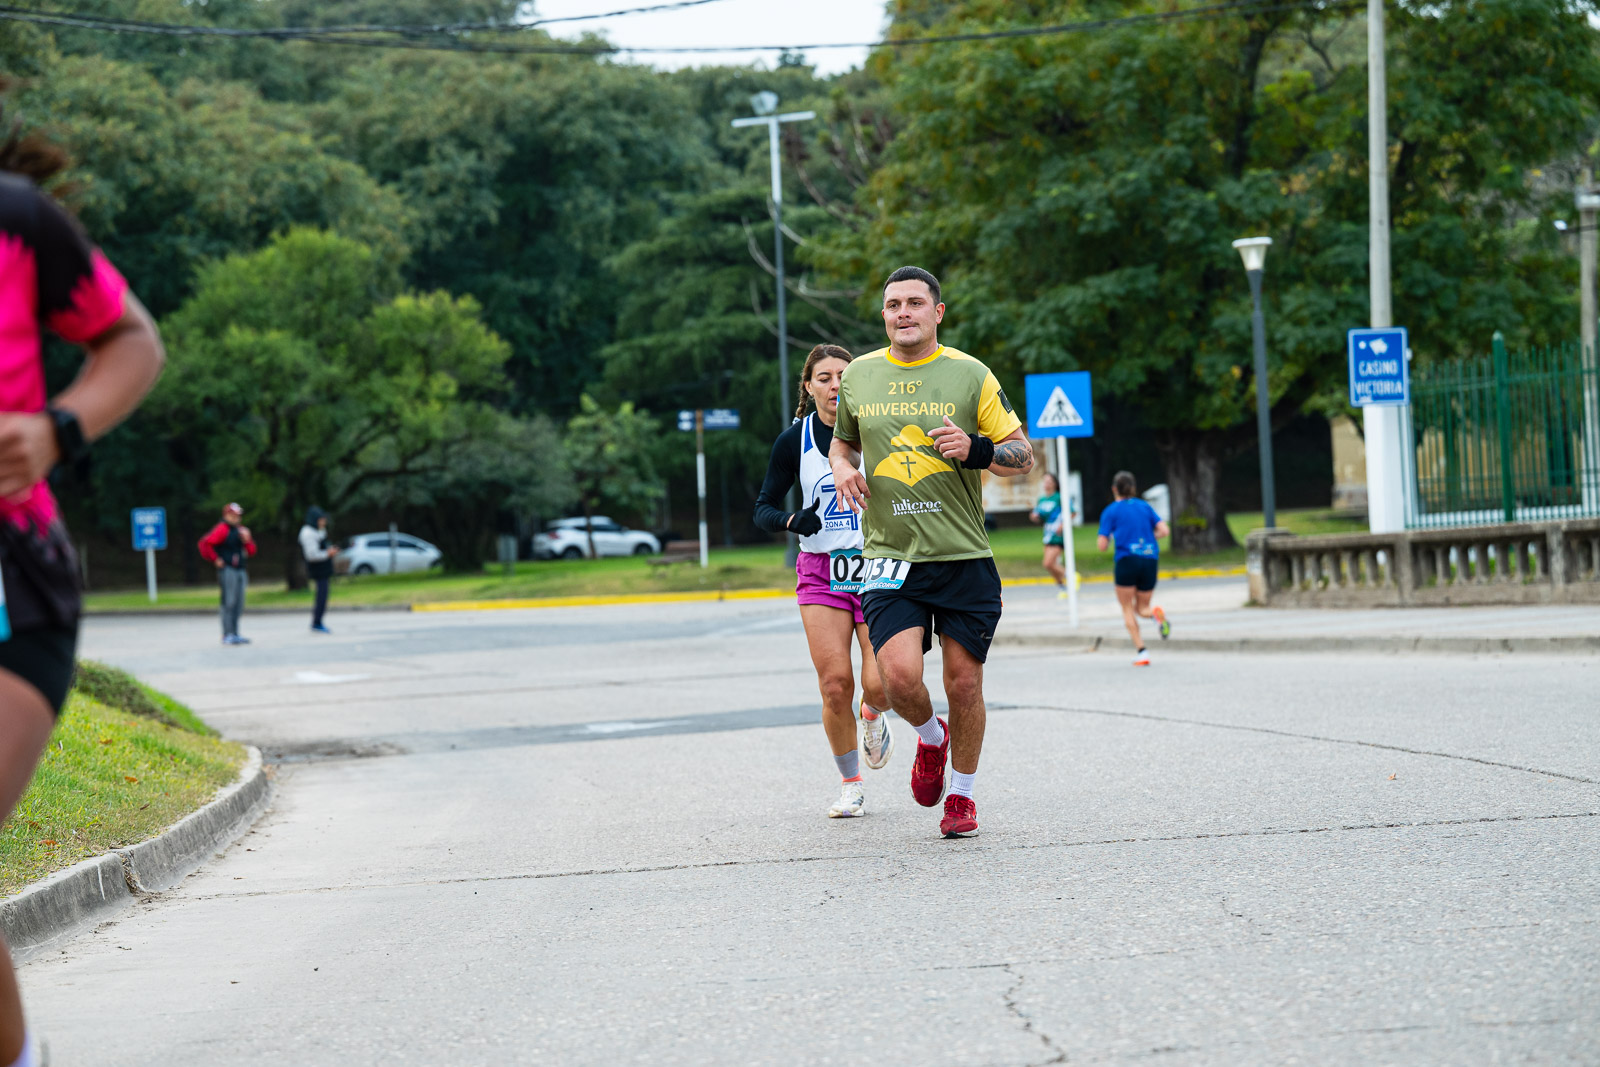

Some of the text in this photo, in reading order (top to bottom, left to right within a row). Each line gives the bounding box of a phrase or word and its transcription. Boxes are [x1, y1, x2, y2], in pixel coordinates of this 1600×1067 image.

[1359, 360, 1398, 377] CASINO
[888, 380, 923, 395] 216°
[1355, 380, 1403, 396] VICTORIA
[858, 402, 956, 418] ANIVERSARIO
[825, 520, 844, 529] ZONA
[833, 554, 865, 583] 02
